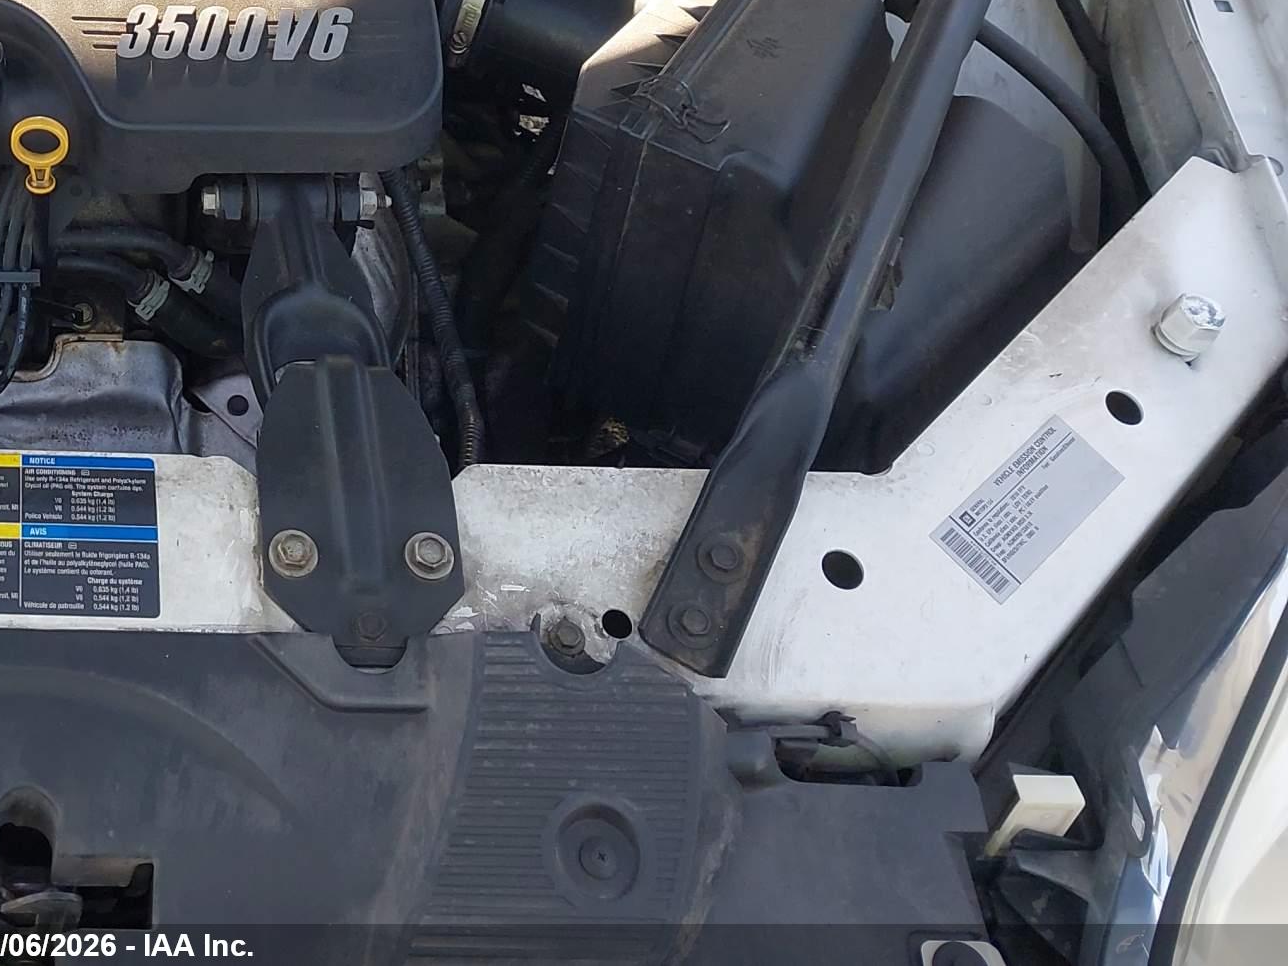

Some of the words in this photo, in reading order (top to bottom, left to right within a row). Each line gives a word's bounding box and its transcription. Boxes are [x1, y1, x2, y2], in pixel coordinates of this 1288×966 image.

[116, 4, 268, 61] 3500
[993, 465, 1015, 486] VEHICLE
[1011, 445, 1036, 468] EMISSION
[1033, 425, 1056, 448] CONTROL
[1015, 445, 1049, 477] INFORMATION
